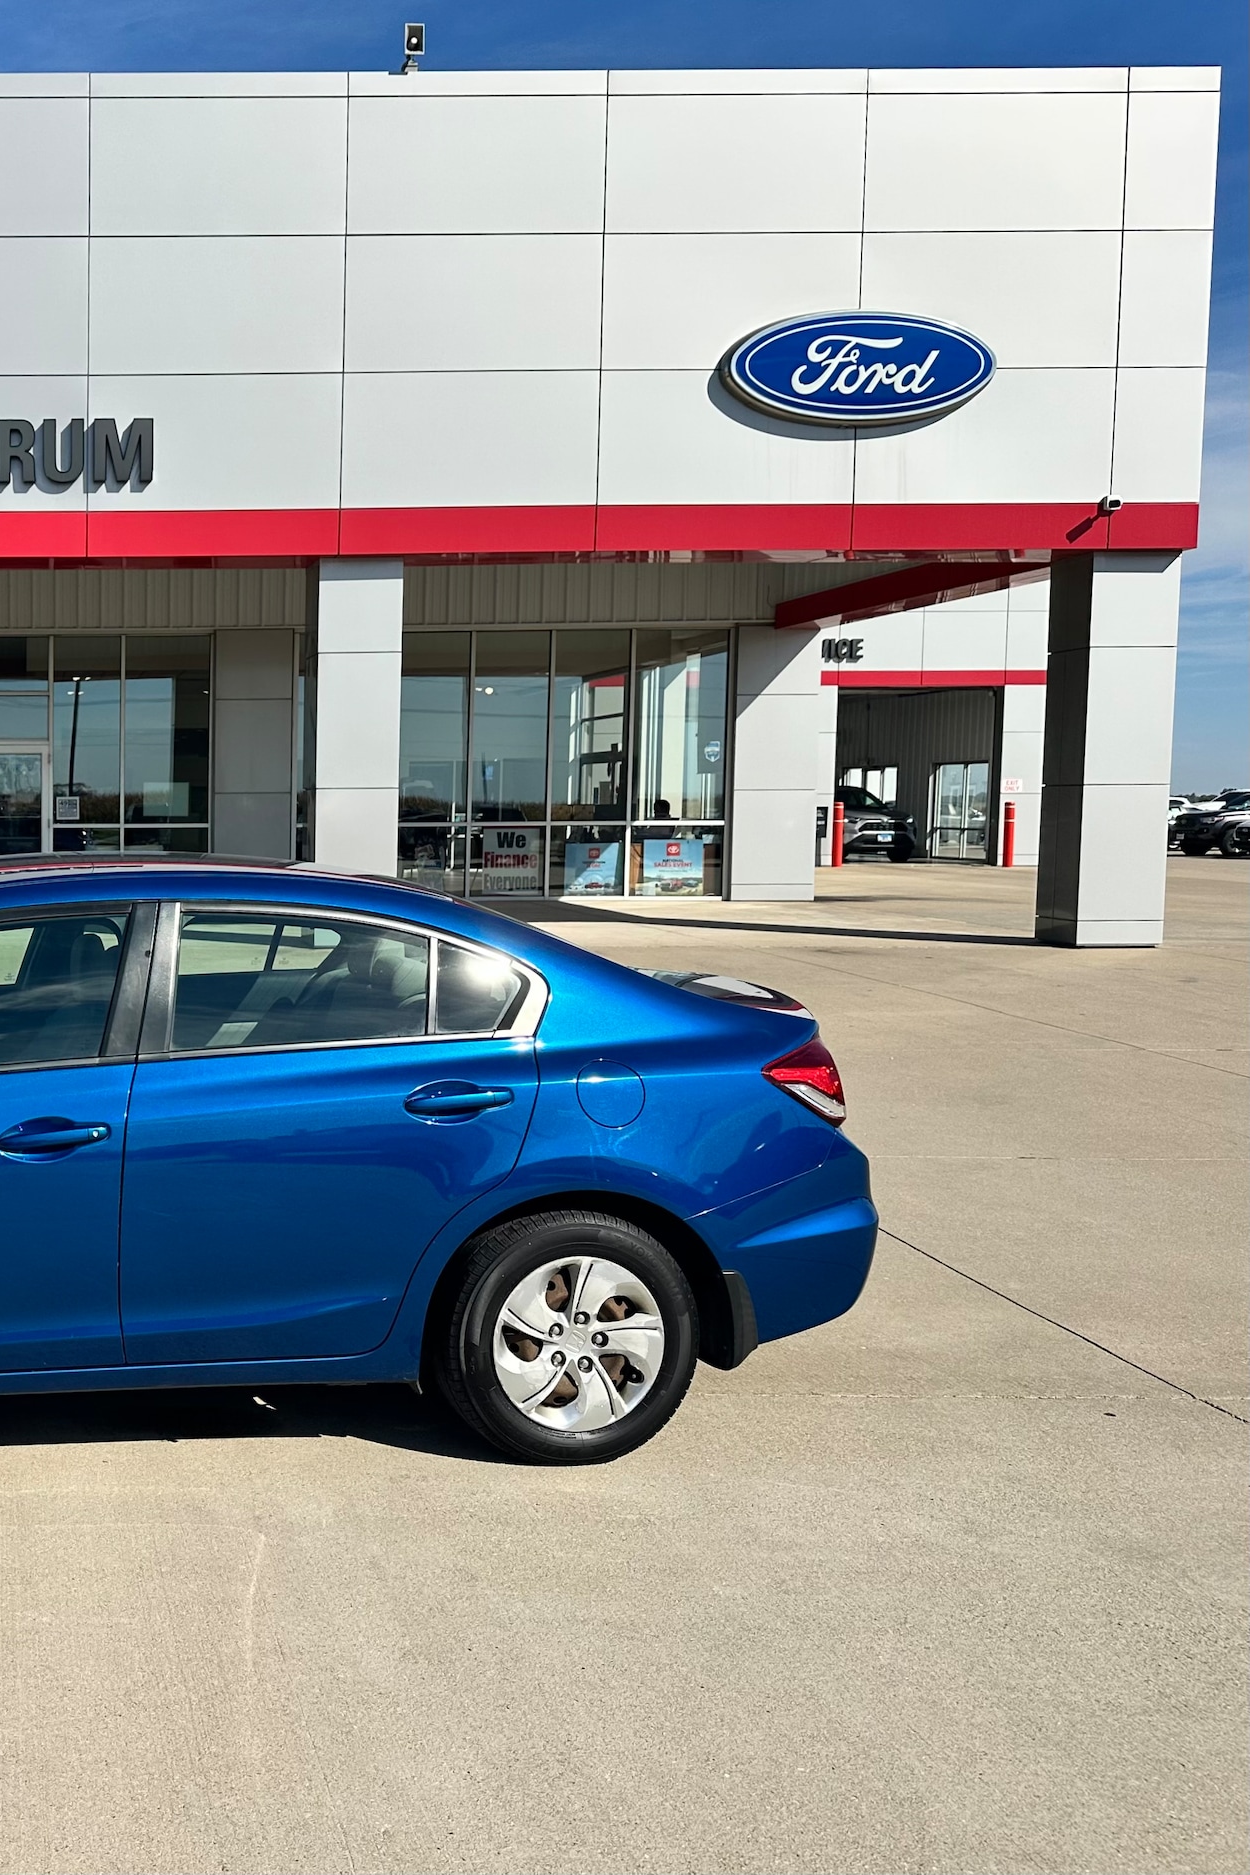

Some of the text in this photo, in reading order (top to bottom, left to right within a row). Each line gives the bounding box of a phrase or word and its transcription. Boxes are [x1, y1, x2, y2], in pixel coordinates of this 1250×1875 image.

[791, 335, 940, 395] Ford
[496, 831, 527, 849] We
[483, 851, 538, 869] Finance
[483, 873, 538, 892] Everyone
